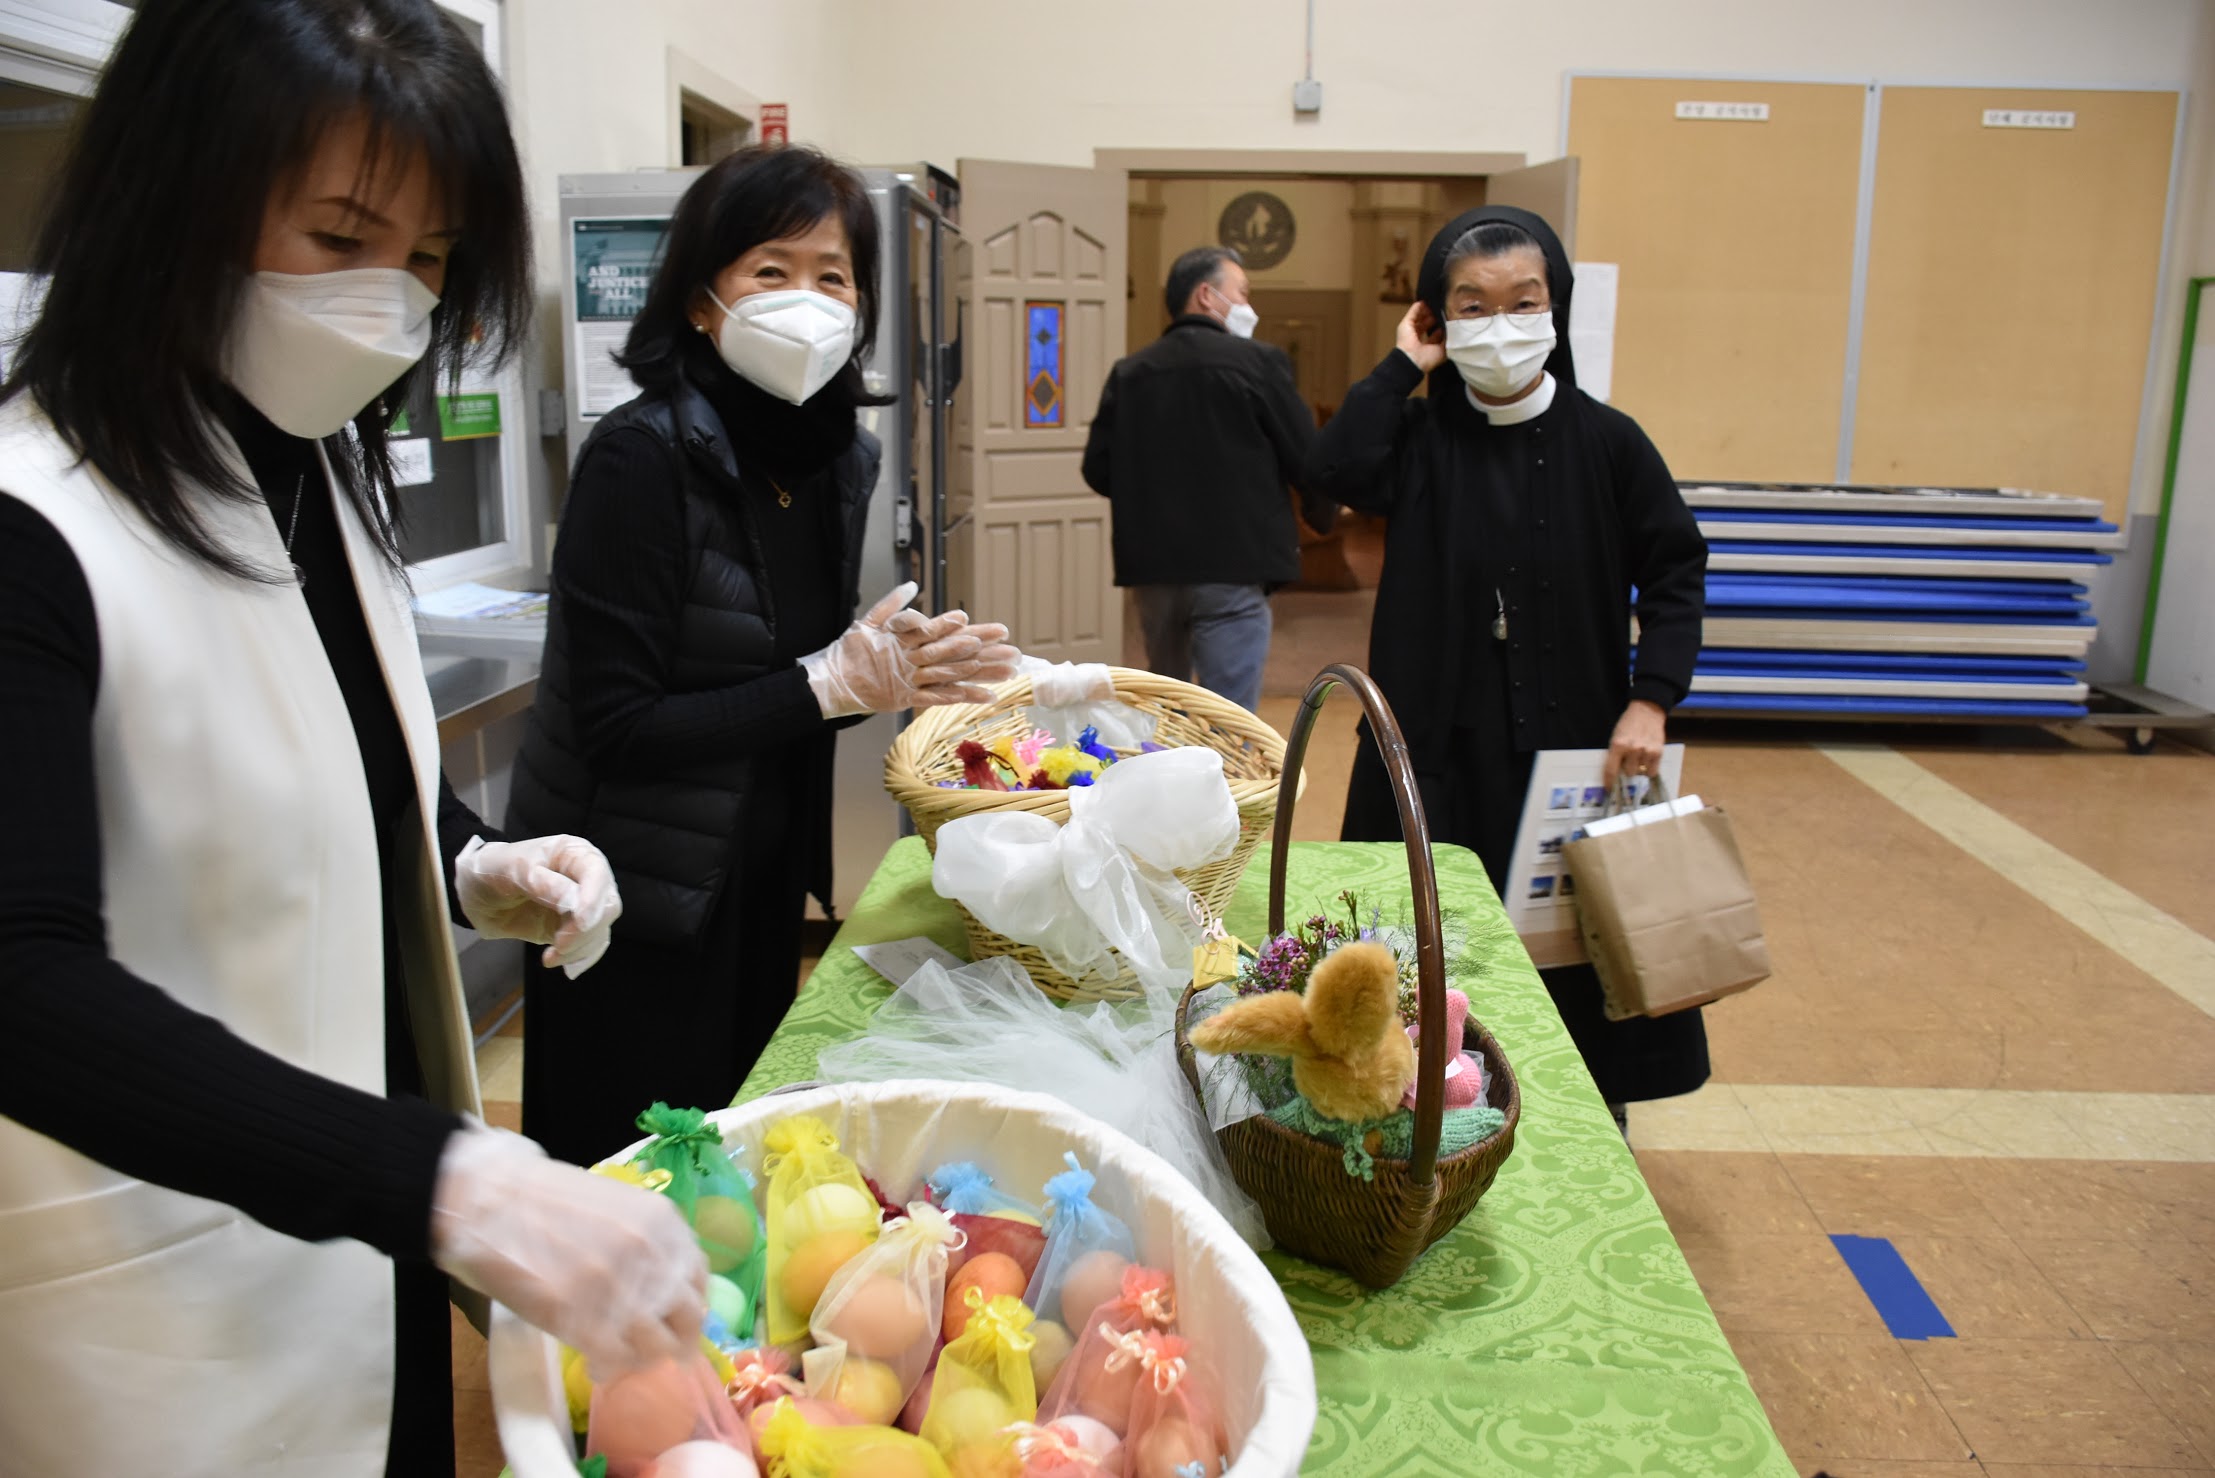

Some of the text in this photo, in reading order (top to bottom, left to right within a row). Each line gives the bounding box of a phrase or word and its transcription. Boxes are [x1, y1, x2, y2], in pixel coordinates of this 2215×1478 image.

[588, 265, 620, 277] AND
[587, 276, 649, 289] JUSTICE
[604, 288, 634, 300] ALL
